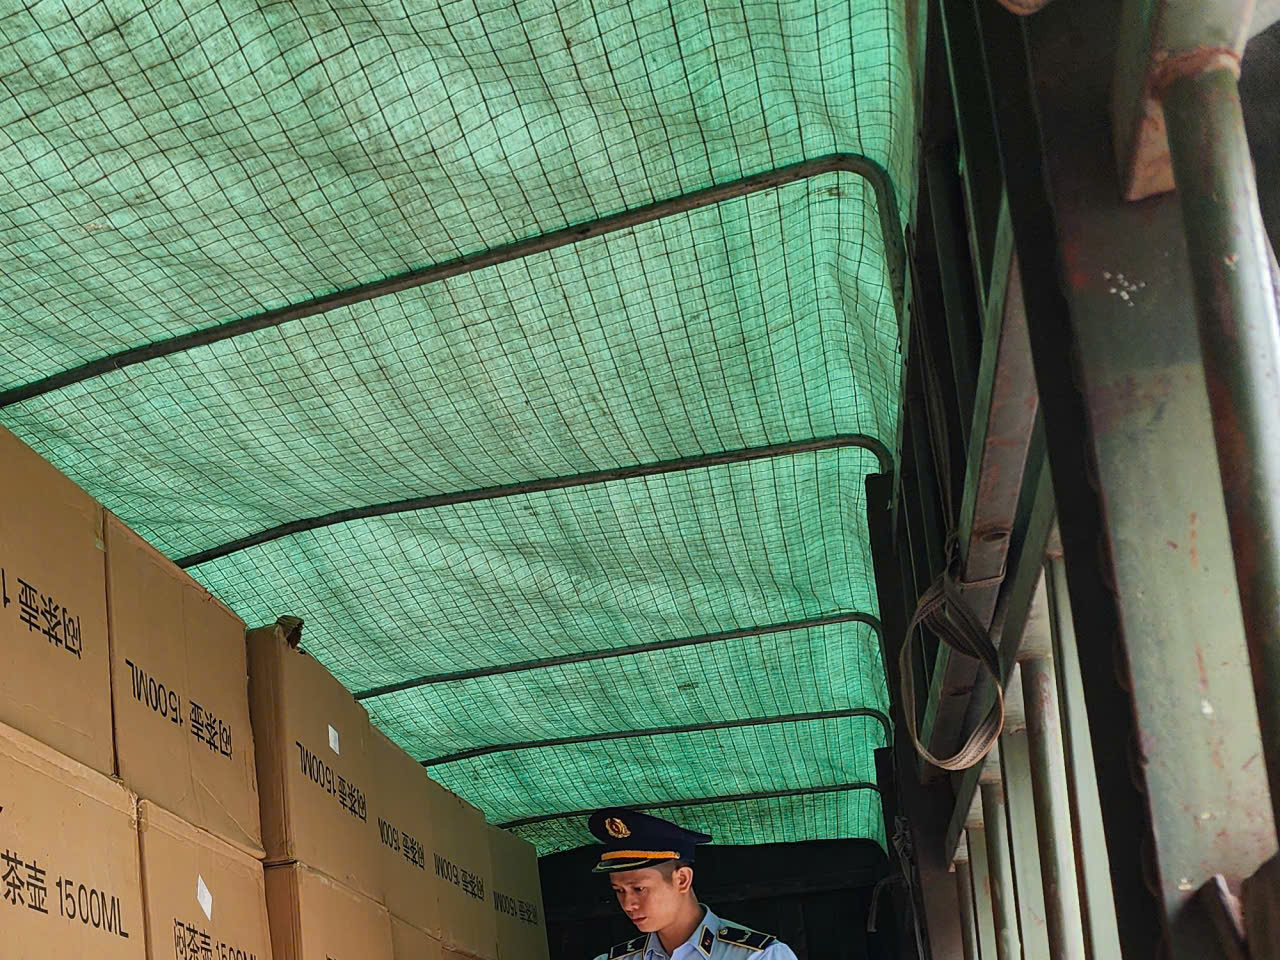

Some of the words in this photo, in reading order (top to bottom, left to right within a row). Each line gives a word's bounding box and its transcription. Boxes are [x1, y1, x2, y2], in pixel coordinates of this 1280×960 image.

[17, 576, 83, 660] 闷茶壶
[125, 658, 184, 727] 1500ML
[189, 699, 233, 761] 闷茶壶
[295, 740, 337, 798] 1500ML
[55, 875, 129, 939] 1500ML
